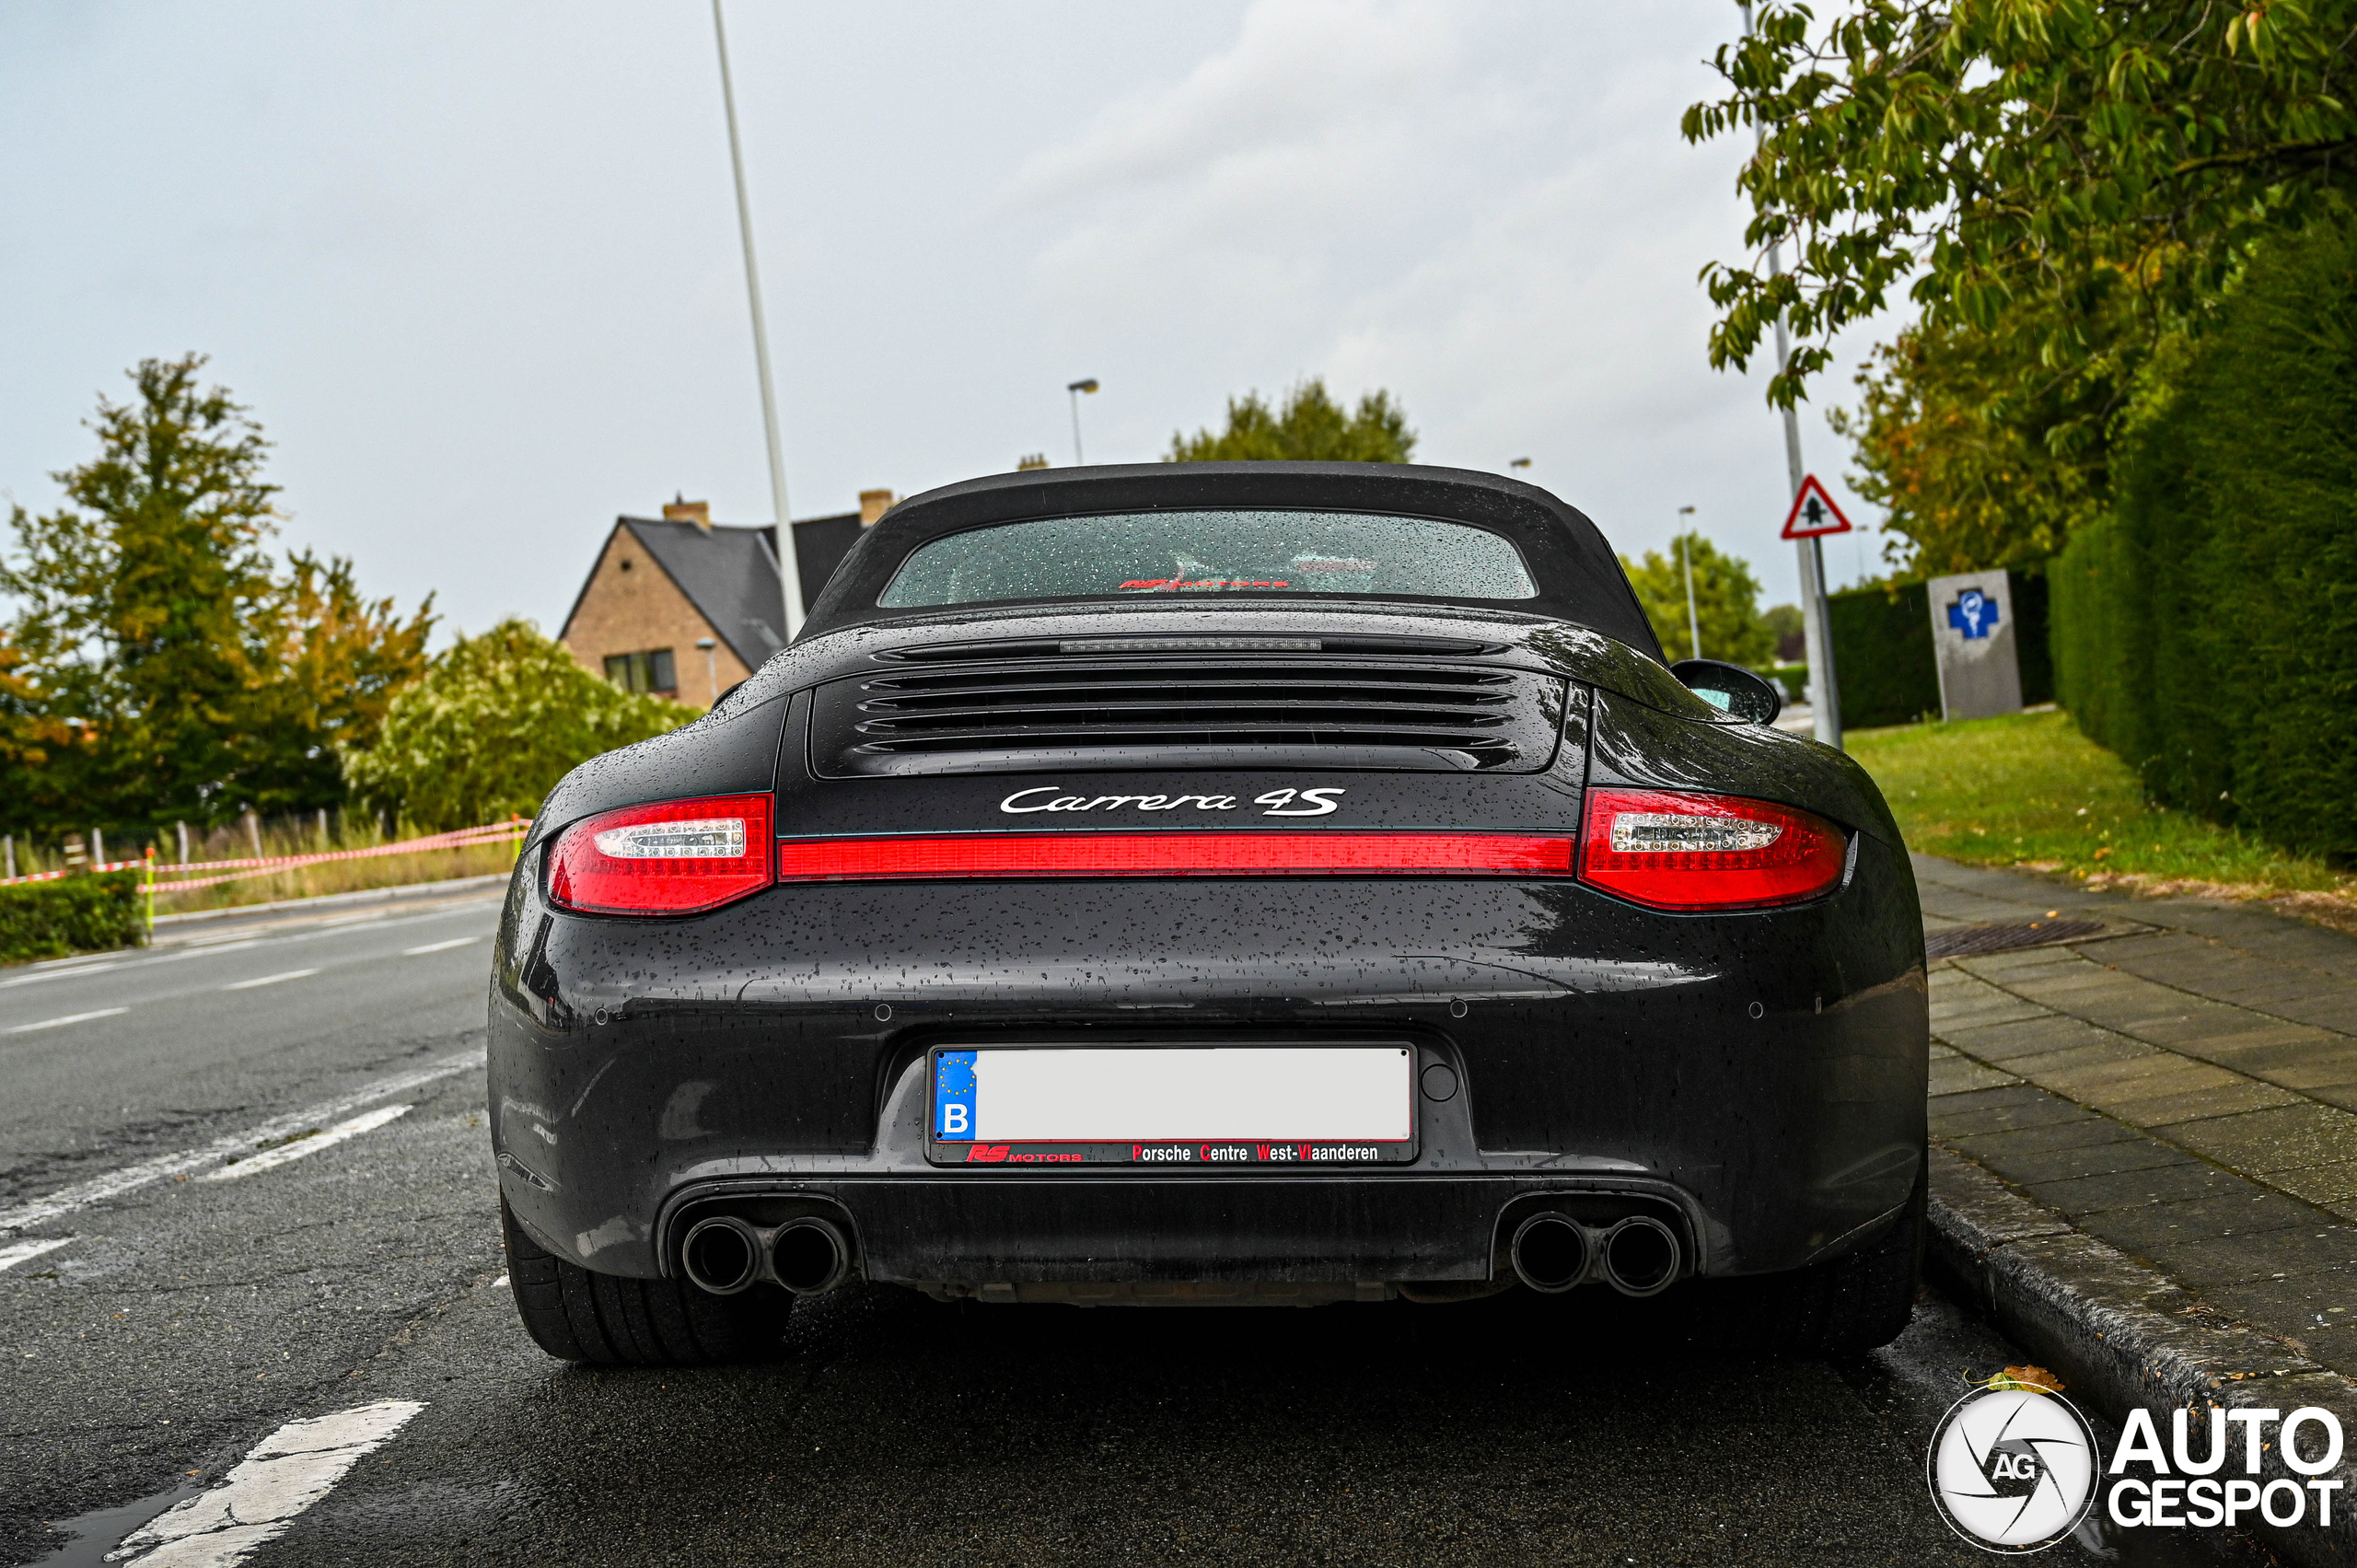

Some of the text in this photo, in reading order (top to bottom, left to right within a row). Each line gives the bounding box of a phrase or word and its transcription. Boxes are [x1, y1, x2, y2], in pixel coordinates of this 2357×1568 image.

[1000, 786, 1346, 817] Carrera 4S
[944, 1103, 969, 1133] B
[967, 1144, 1084, 1162] RS MOTORS
[1132, 1144, 1378, 1161] Porsche Centre West-Vlaanderen
